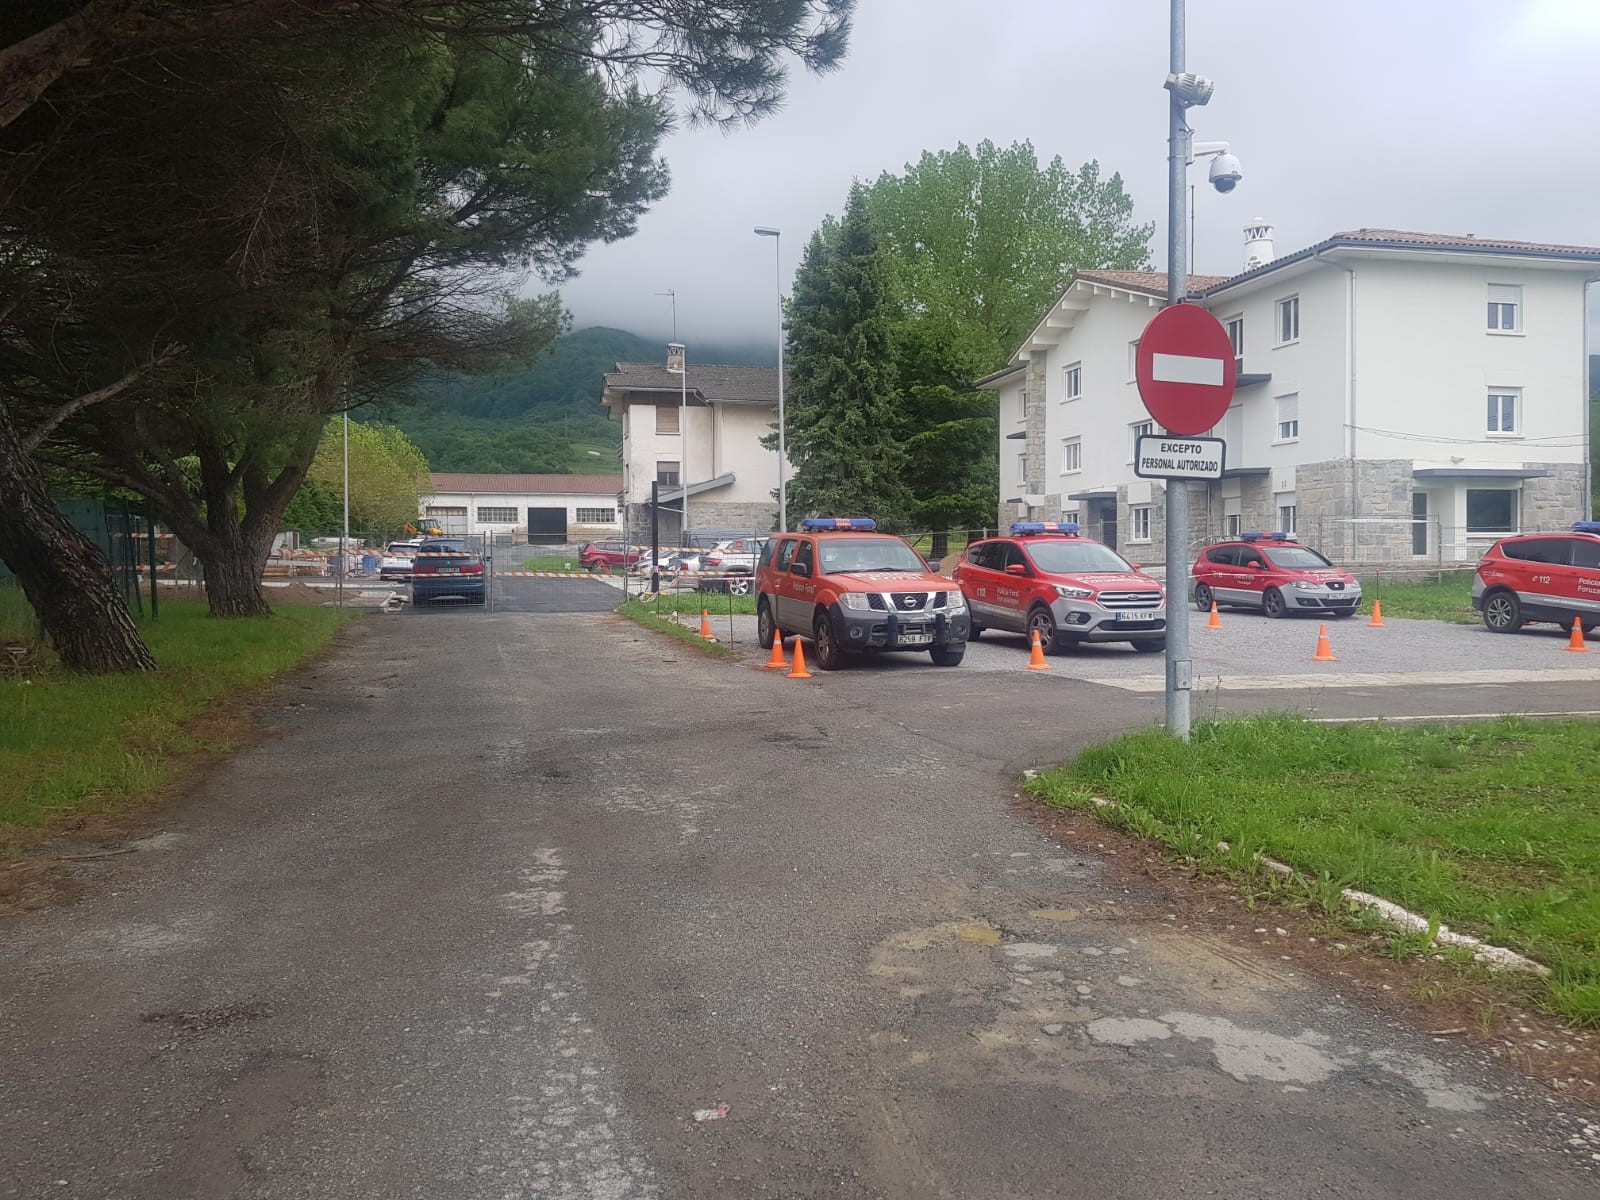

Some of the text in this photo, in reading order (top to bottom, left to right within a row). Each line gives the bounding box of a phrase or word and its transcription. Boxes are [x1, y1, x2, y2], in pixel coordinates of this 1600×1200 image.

[1161, 443, 1202, 454] EXCEPTO
[1142, 457, 1218, 472] PERSONAL AUTORIZADO
[1539, 575, 1551, 584] 112
